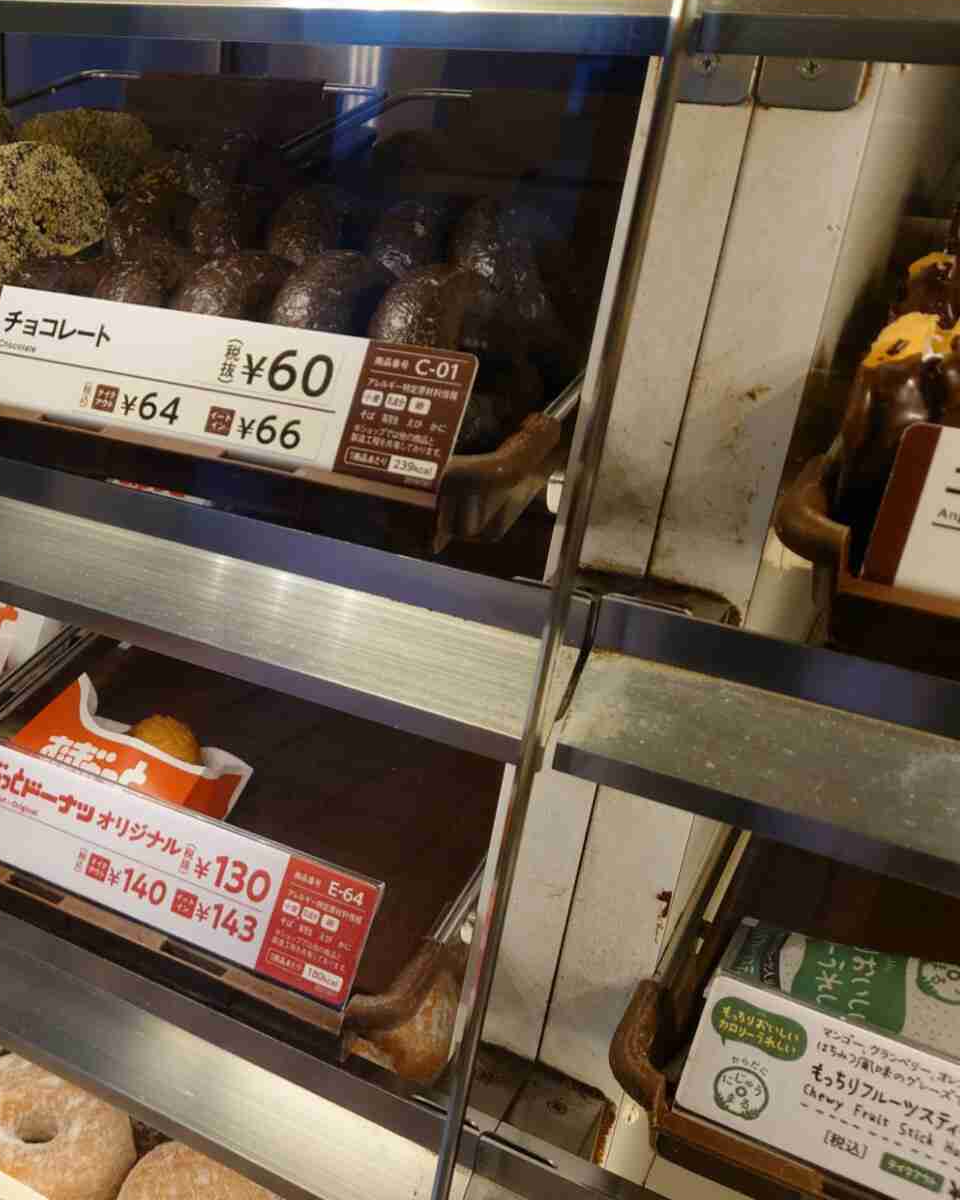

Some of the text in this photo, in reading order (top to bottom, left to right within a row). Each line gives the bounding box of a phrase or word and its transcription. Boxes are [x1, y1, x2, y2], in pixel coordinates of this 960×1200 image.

[3, 310, 111, 349] チョコレート
[240, 348, 335, 399] ¥60
[414, 357, 459, 382] C-01
[119, 390, 302, 452] ¥64 ¥66
[96, 810, 182, 857] オリジナル
[193, 855, 272, 903] ¥130
[328, 881, 365, 907] E-64
[107, 866, 259, 943] ¥140 ¥143
[802, 1082, 935, 1147] Chewy Fruit Stick
